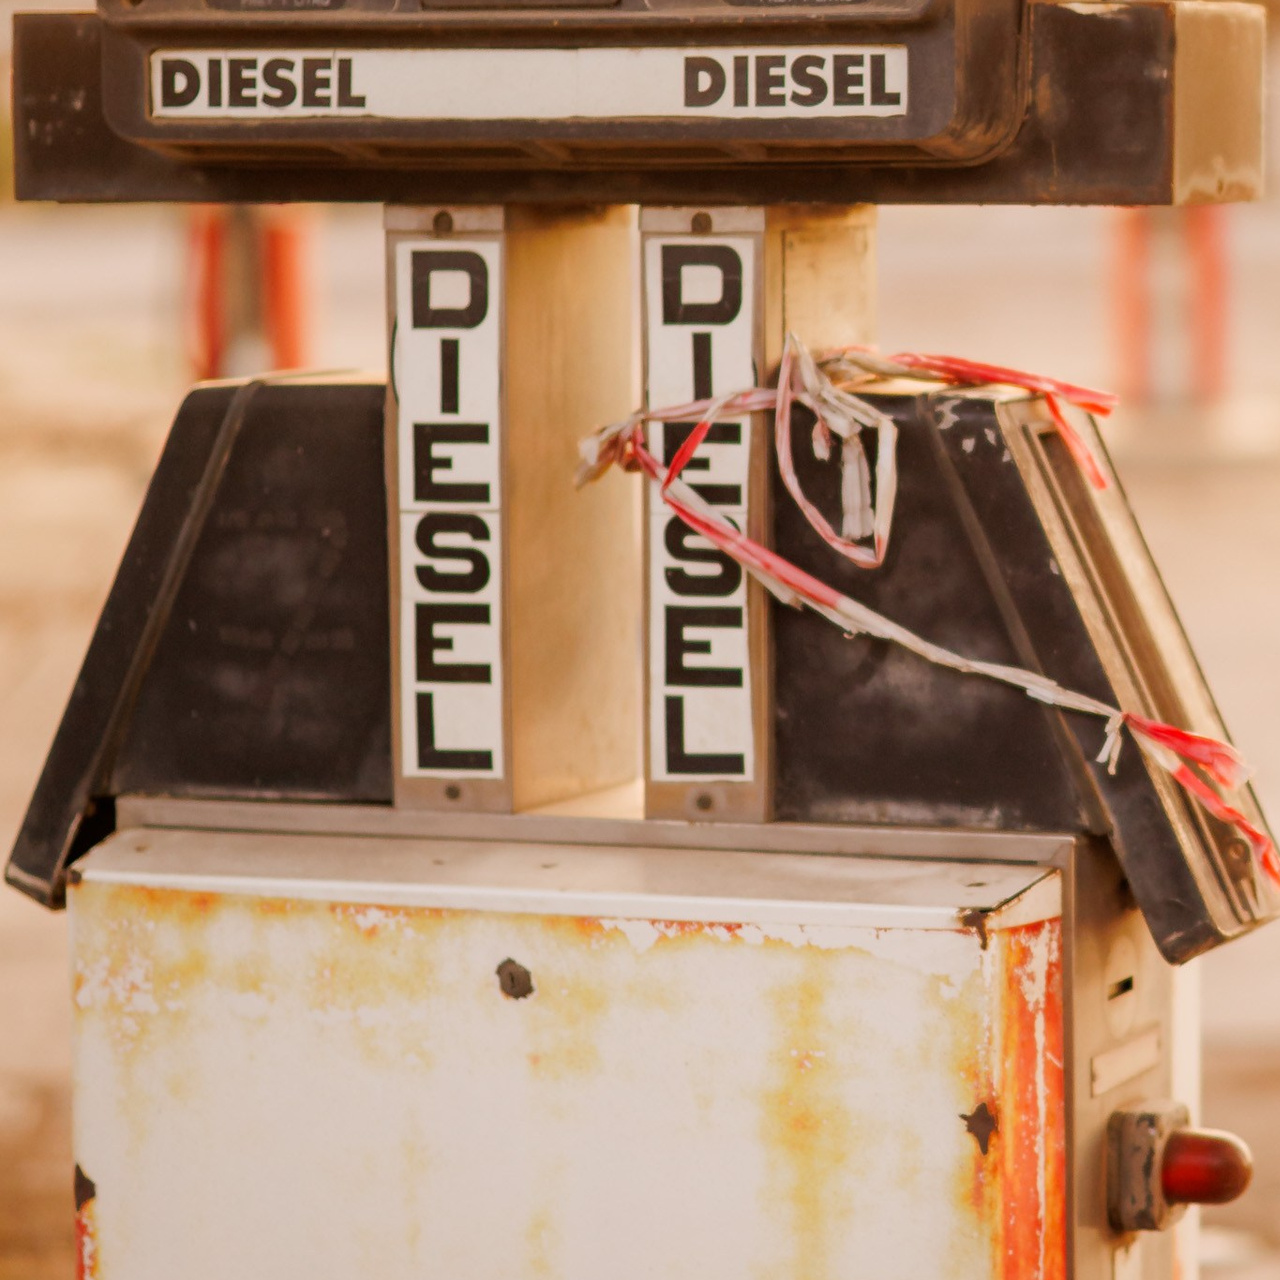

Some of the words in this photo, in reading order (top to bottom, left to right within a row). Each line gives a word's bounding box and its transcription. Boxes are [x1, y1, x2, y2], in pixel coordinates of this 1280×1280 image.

[161, 58, 366, 107] DIESEL
[684, 54, 901, 107] DIESEL
[411, 250, 493, 770] DIESEL
[661, 244, 745, 775] DIESEL
